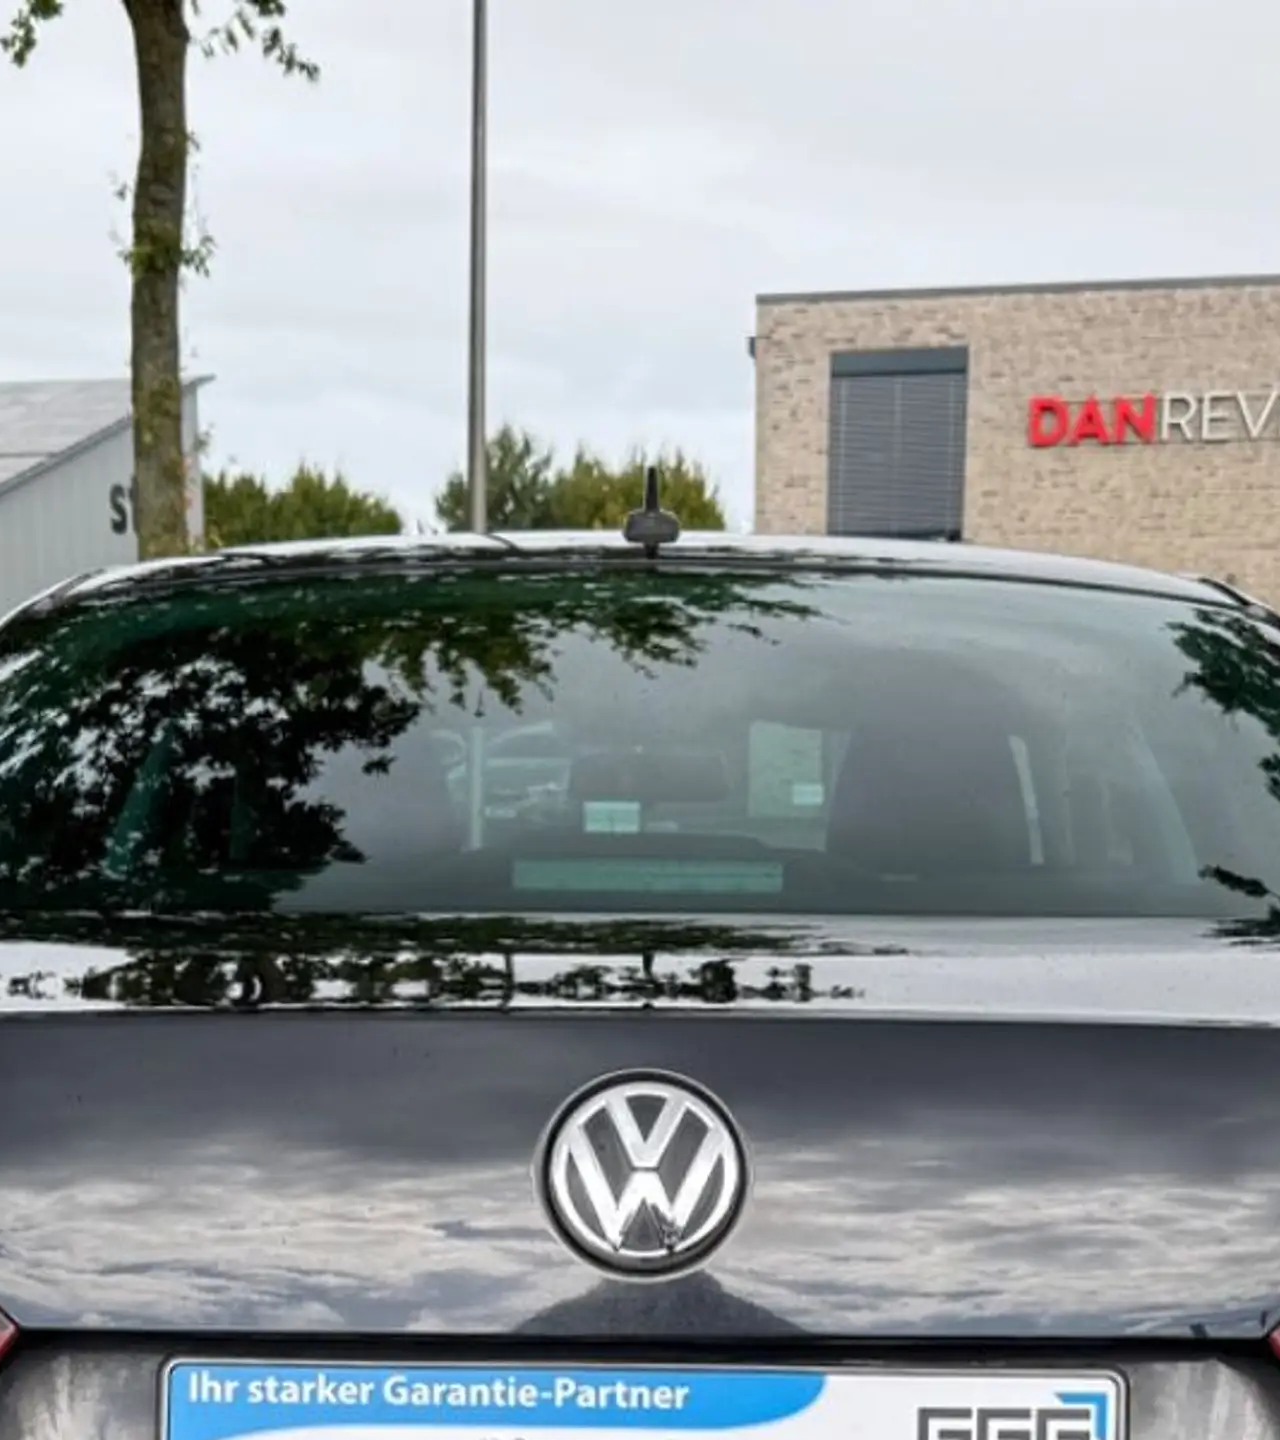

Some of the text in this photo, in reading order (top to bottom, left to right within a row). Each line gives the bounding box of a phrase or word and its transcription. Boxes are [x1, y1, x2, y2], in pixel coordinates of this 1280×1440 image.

[188, 1371, 690, 1409] Ihr starker Garantie-Partner
